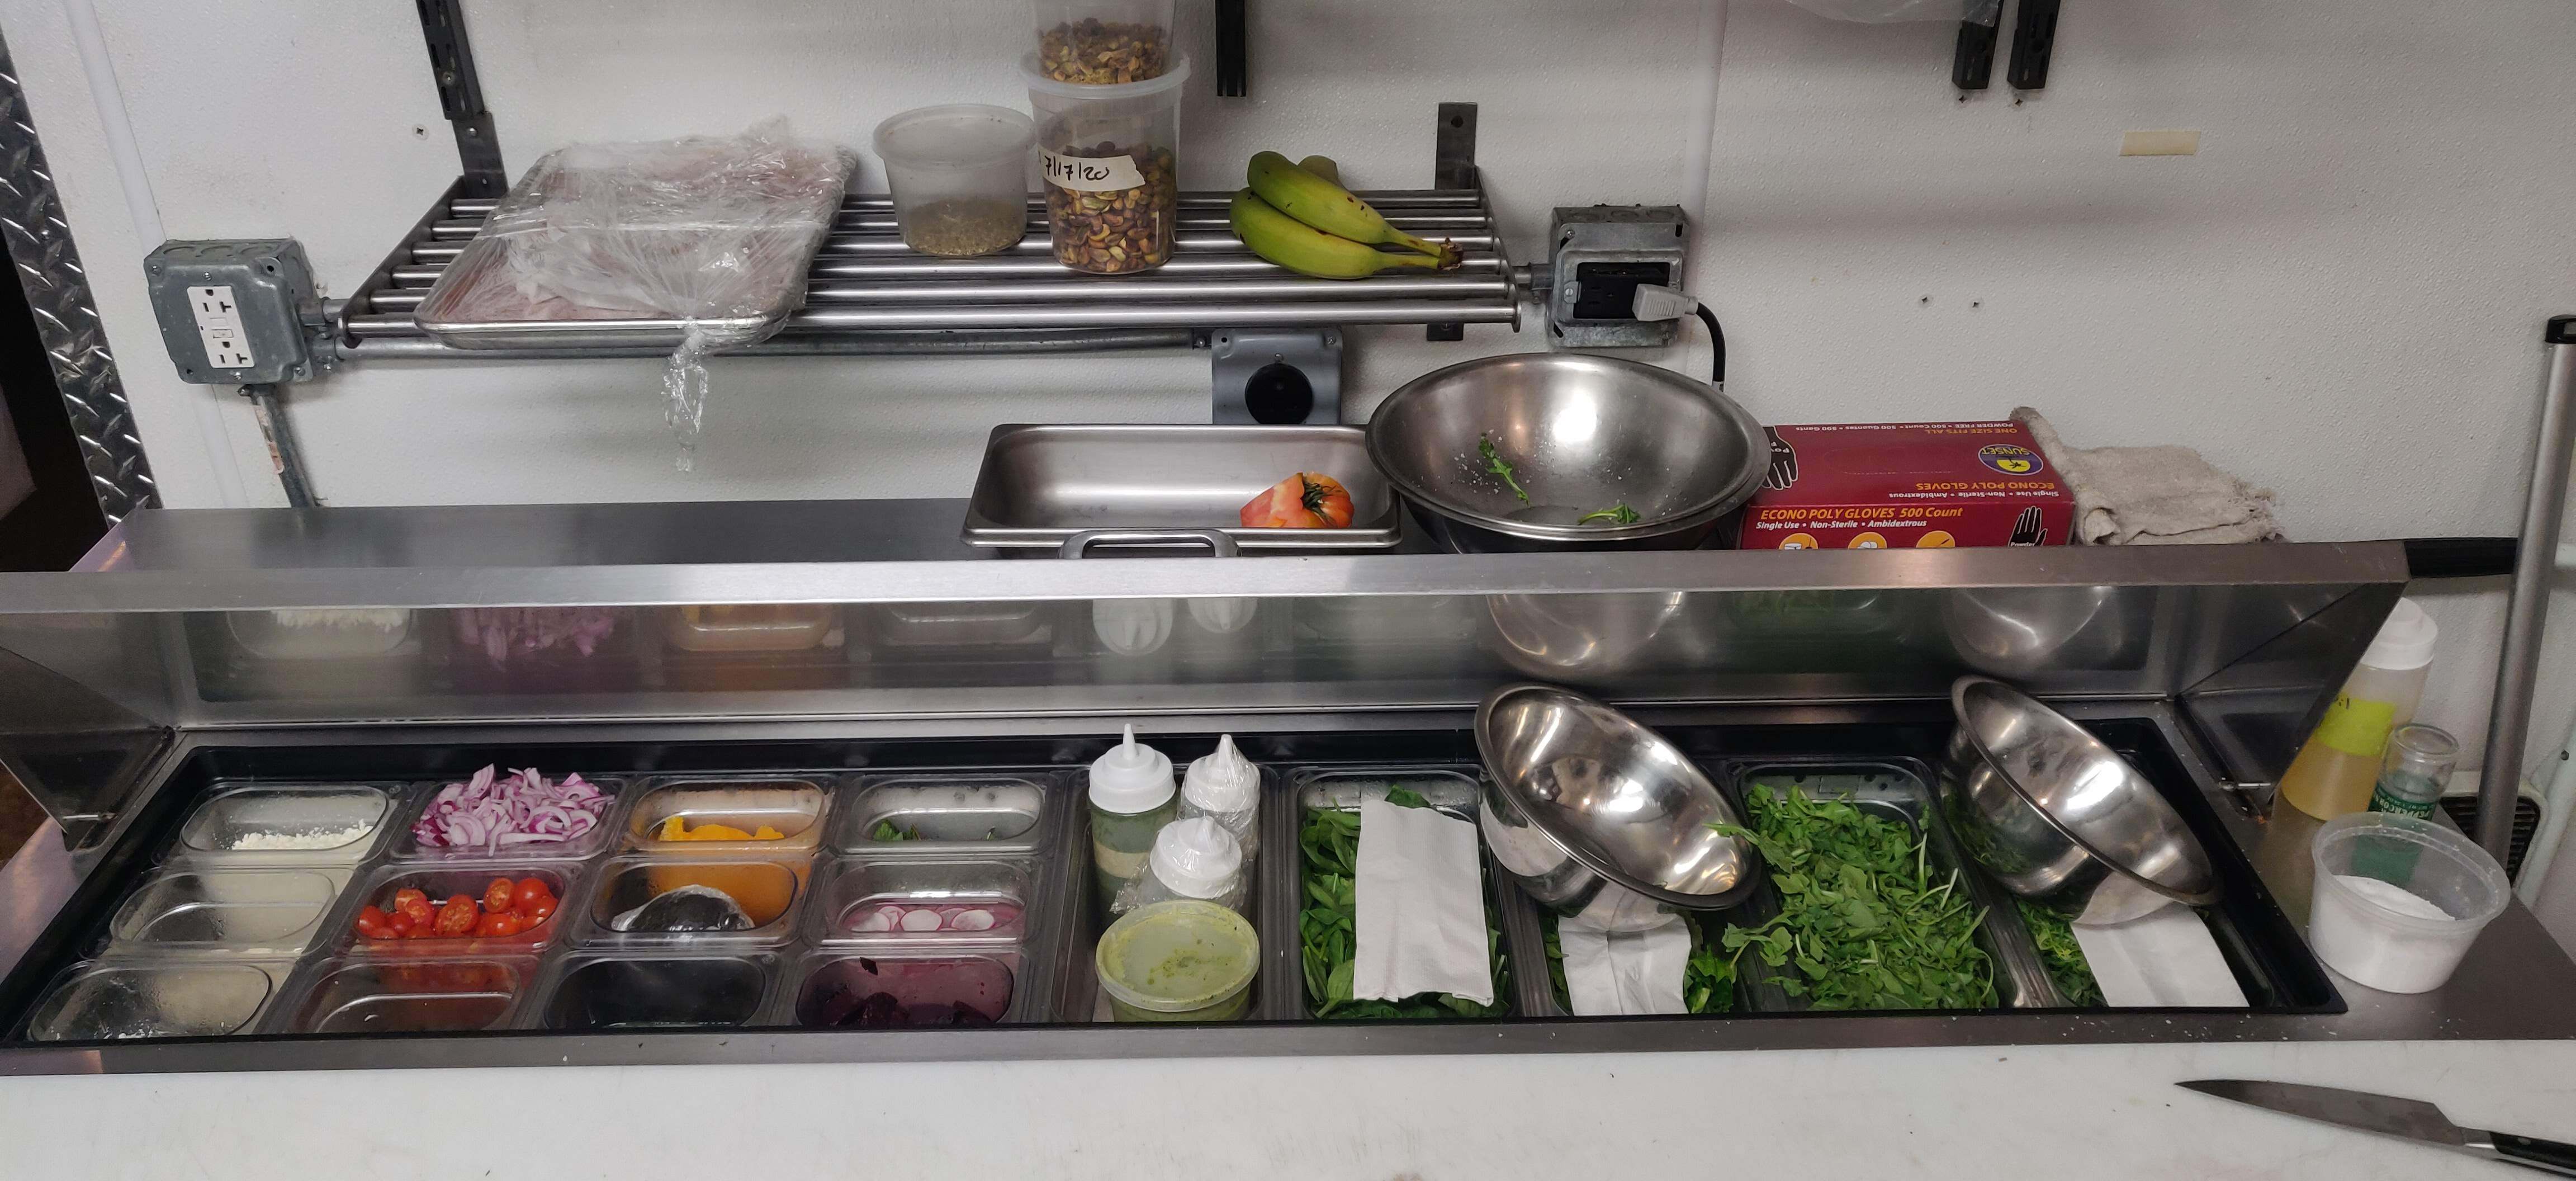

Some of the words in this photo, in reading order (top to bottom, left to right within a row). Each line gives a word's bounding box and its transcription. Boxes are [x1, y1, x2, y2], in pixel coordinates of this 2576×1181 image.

[1044, 155, 1110, 181] 7/17/20
[1760, 509, 1807, 520] ECONO
[1808, 508, 1844, 519] POLY
[1844, 508, 1896, 519] GLOVES
[1900, 508, 1924, 518] 500
[1925, 507, 1963, 517] Count
[1755, 521, 1783, 531] Single
[1810, 520, 1858, 528] Non-Sterile
[1867, 519, 1927, 528] Ambidextrous
